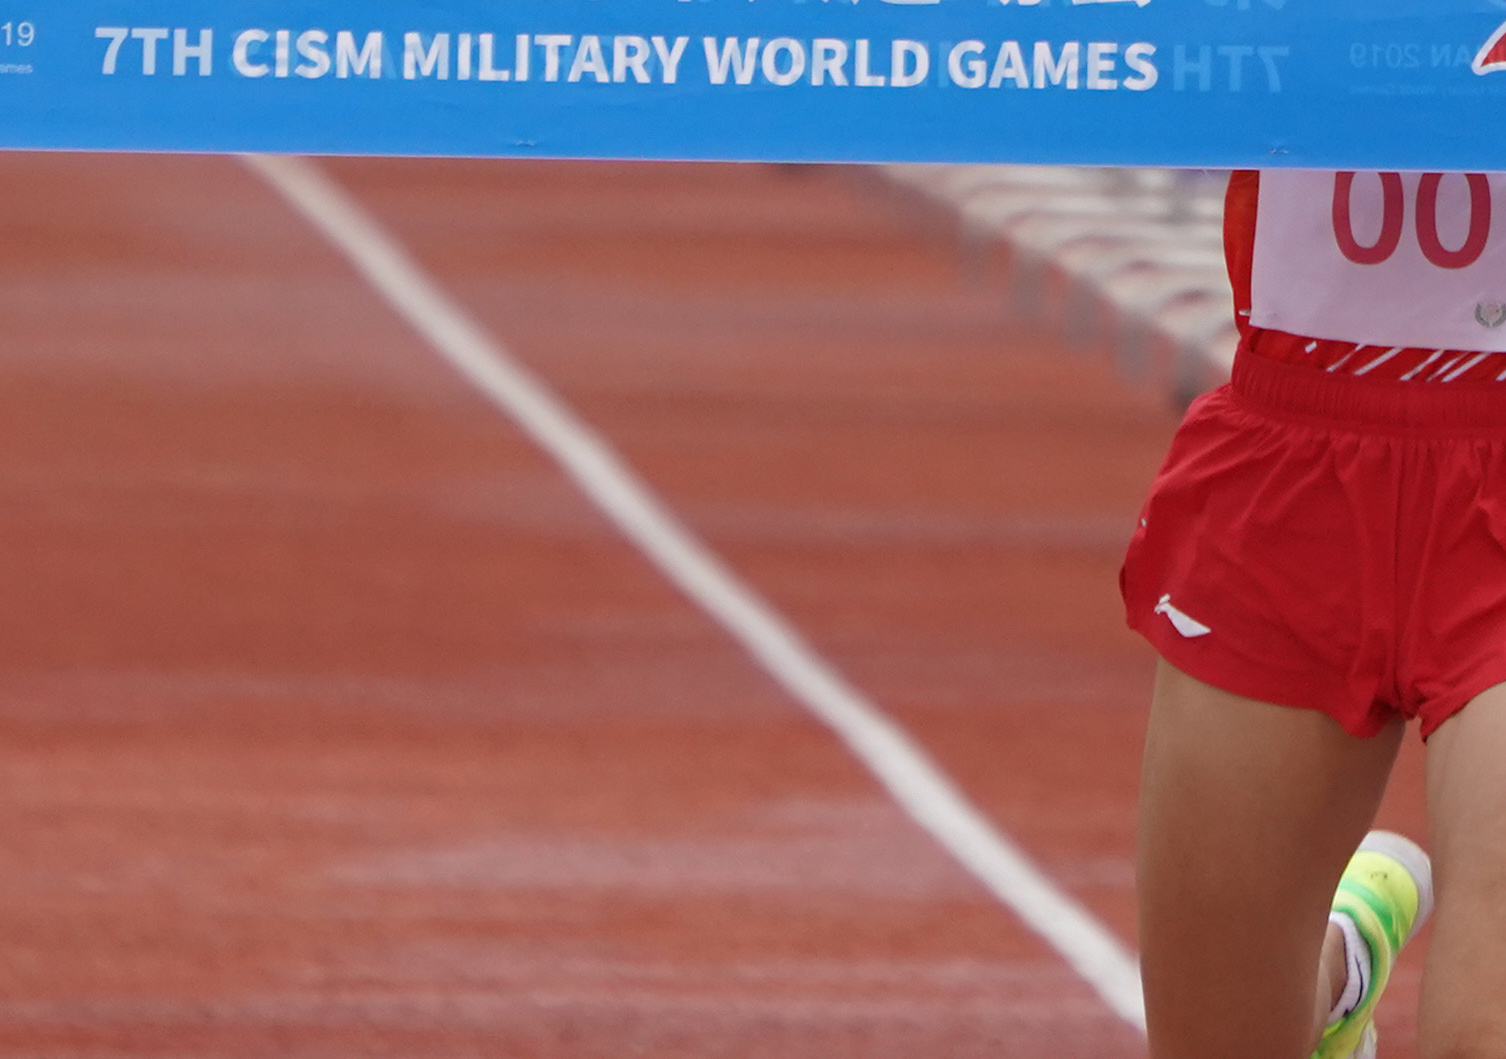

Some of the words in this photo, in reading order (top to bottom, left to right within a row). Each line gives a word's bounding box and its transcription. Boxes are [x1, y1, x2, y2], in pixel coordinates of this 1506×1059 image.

[94, 26, 213, 76] 7TH
[231, 28, 383, 79] CISM
[403, 31, 689, 84] MILITARY
[703, 36, 930, 88] WORLD
[947, 39, 1158, 92] GAMES
